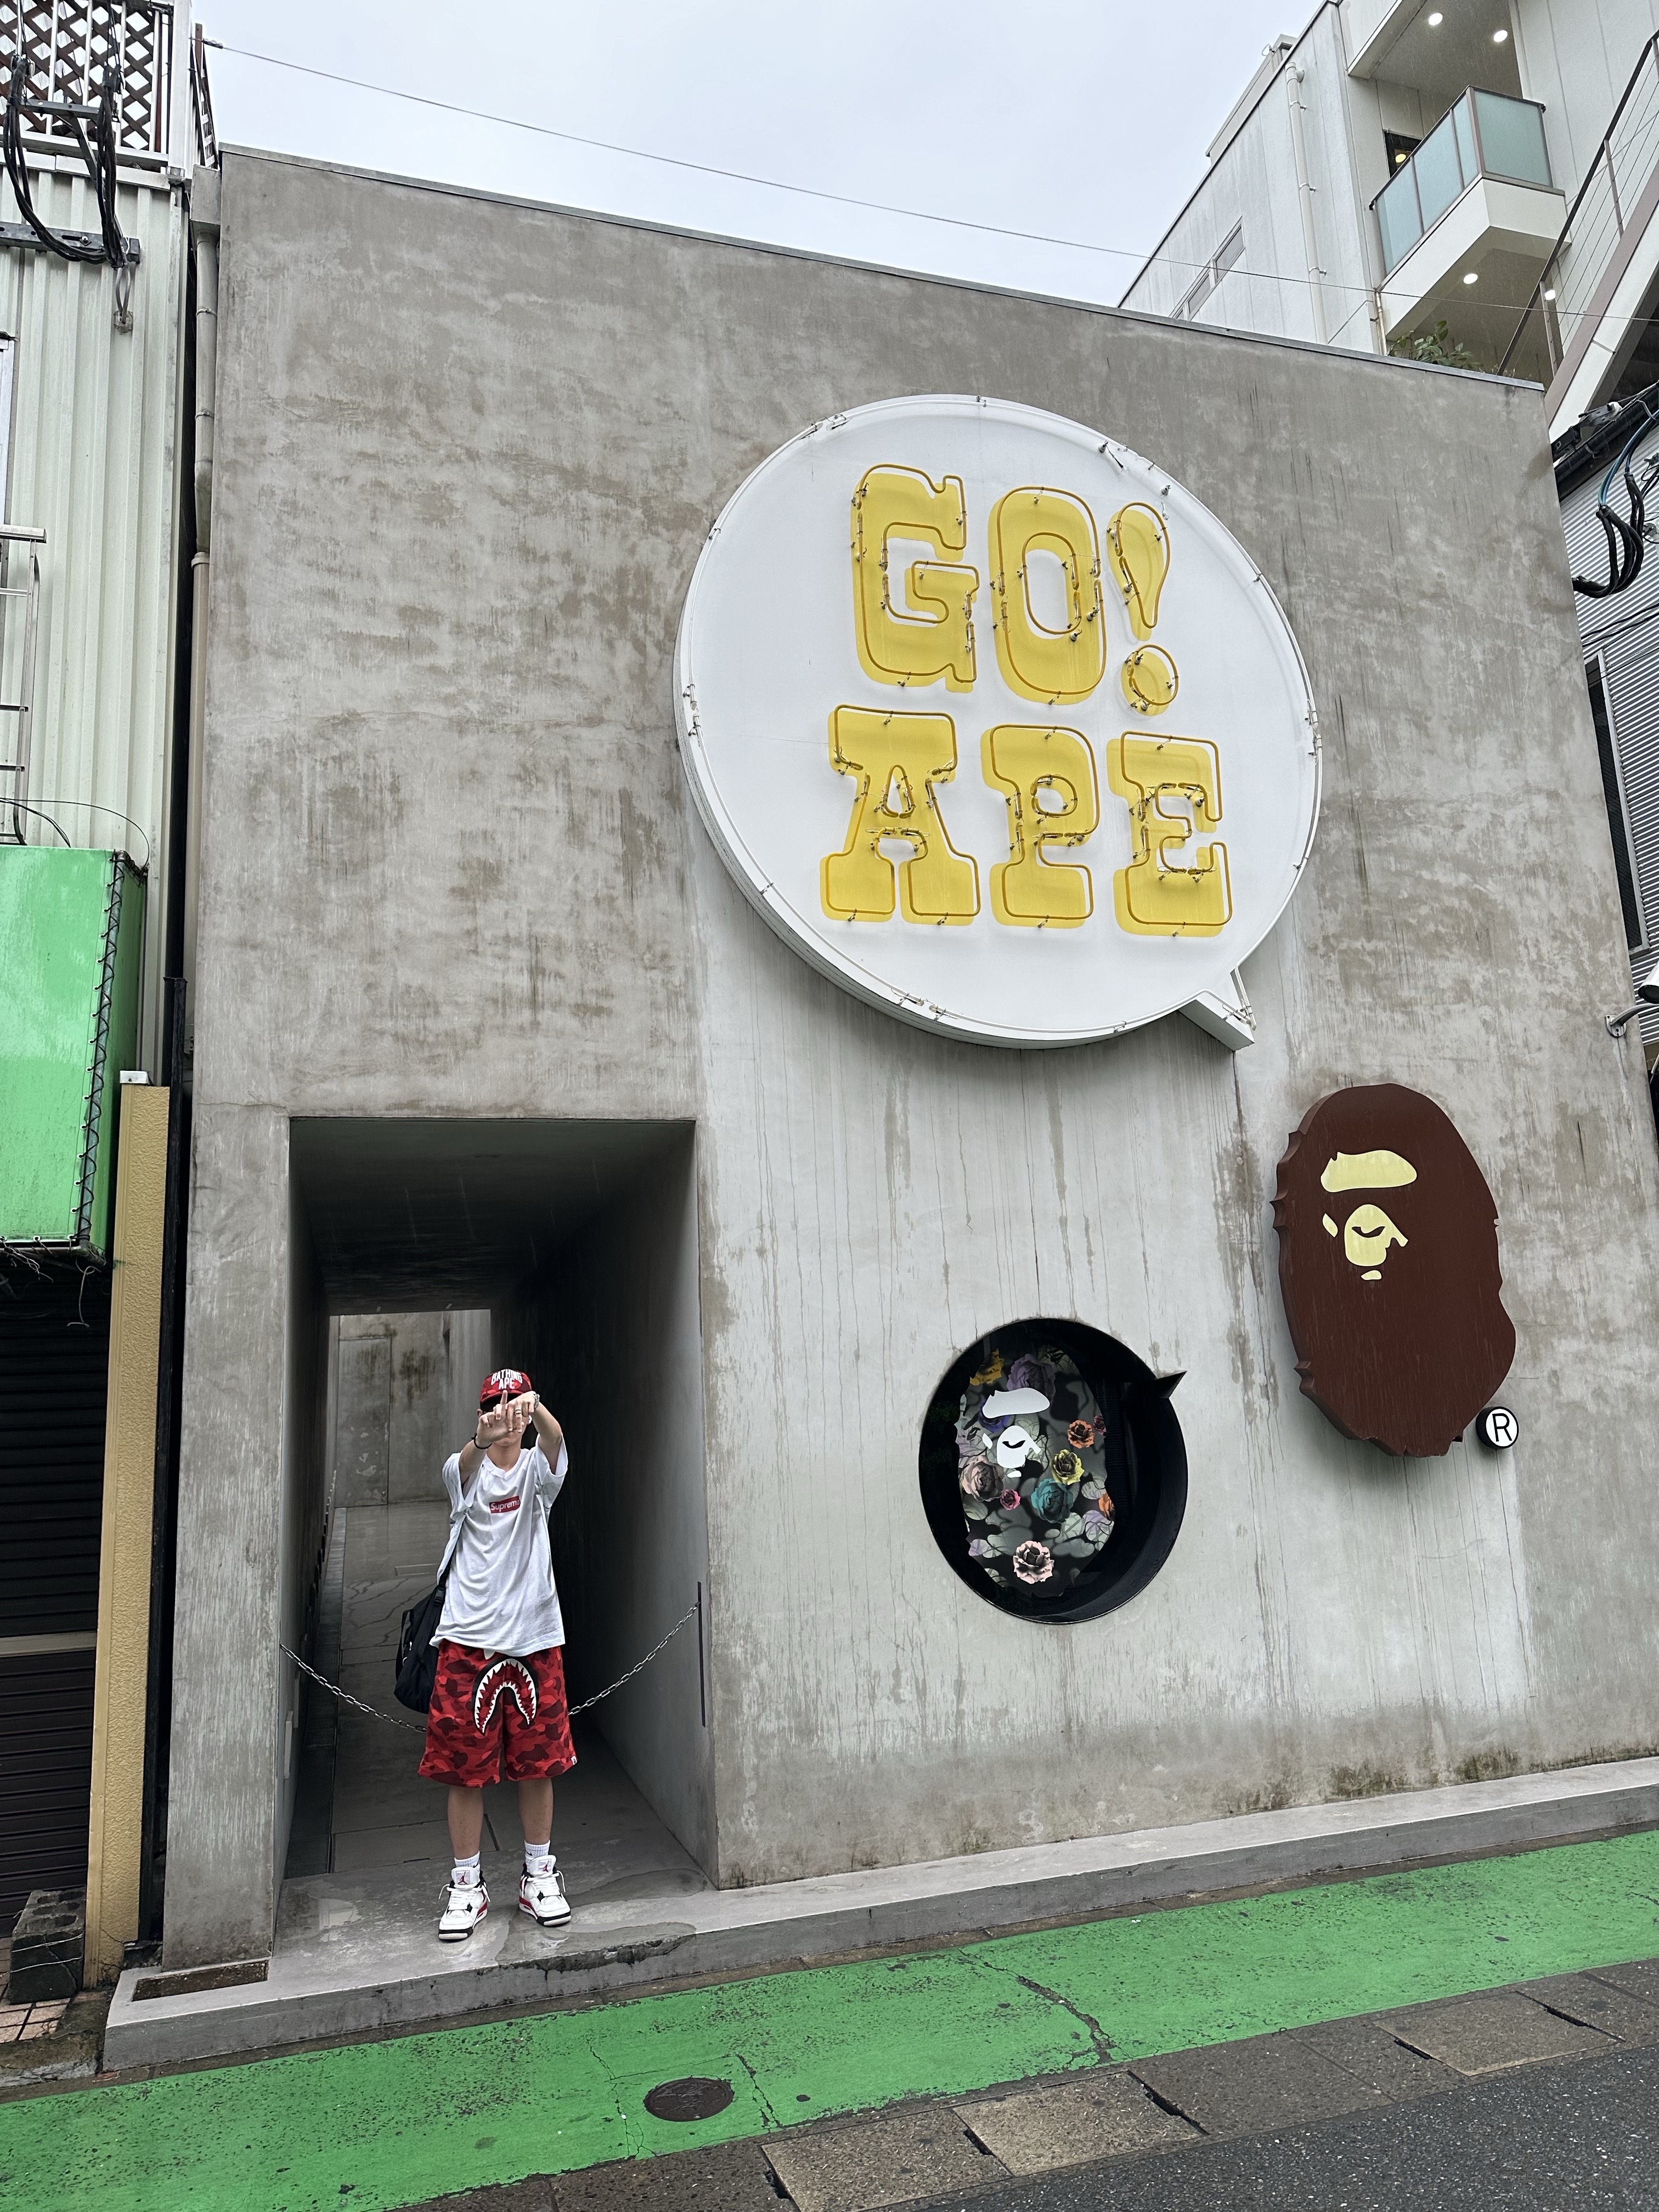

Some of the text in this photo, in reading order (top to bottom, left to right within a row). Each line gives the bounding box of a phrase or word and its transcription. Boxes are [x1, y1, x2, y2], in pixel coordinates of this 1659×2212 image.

[850, 464, 1179, 716] GO!
[820, 704, 1232, 937] APE
[490, 1369, 523, 1386] BATHING
[498, 1378, 516, 1390] APE
